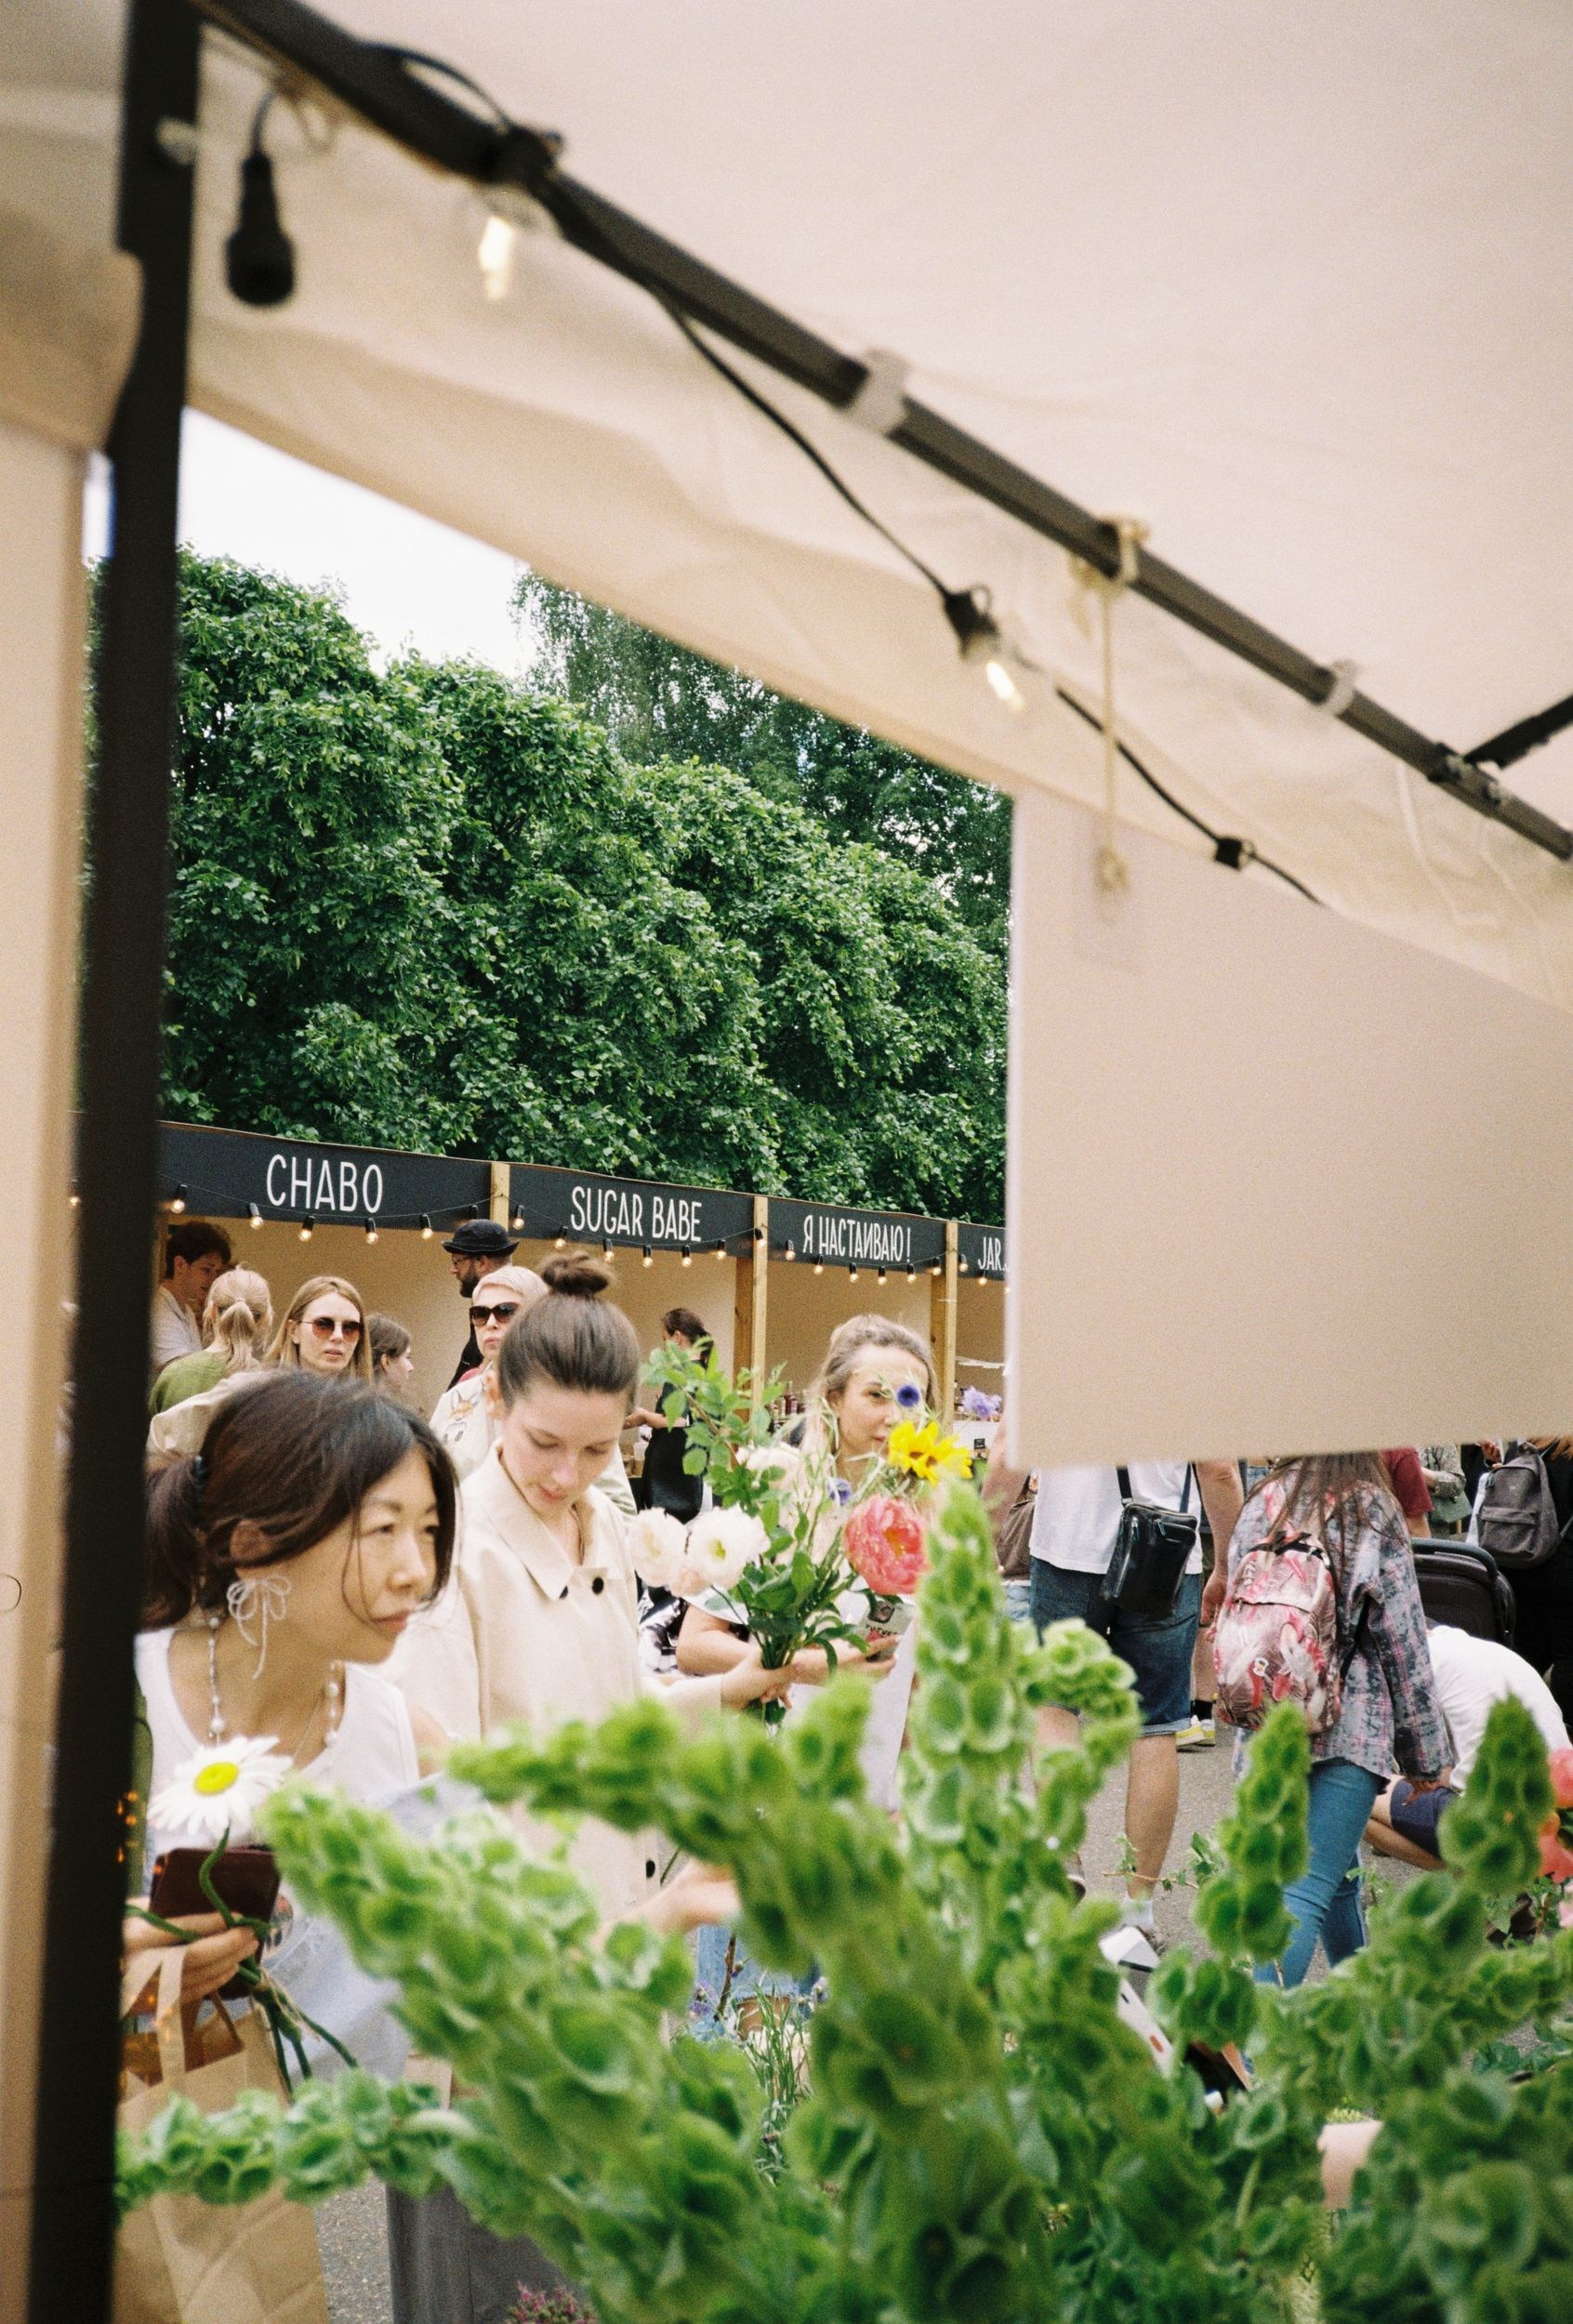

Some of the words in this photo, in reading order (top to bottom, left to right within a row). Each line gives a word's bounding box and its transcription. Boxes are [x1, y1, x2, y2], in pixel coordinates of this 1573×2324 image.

[267, 1154, 383, 1213] CHABO
[570, 1185, 643, 1237] SUGAR
[652, 1195, 703, 1242] BABE
[802, 1214, 813, 1254] Я
[978, 1236, 1009, 1272] JAR.
